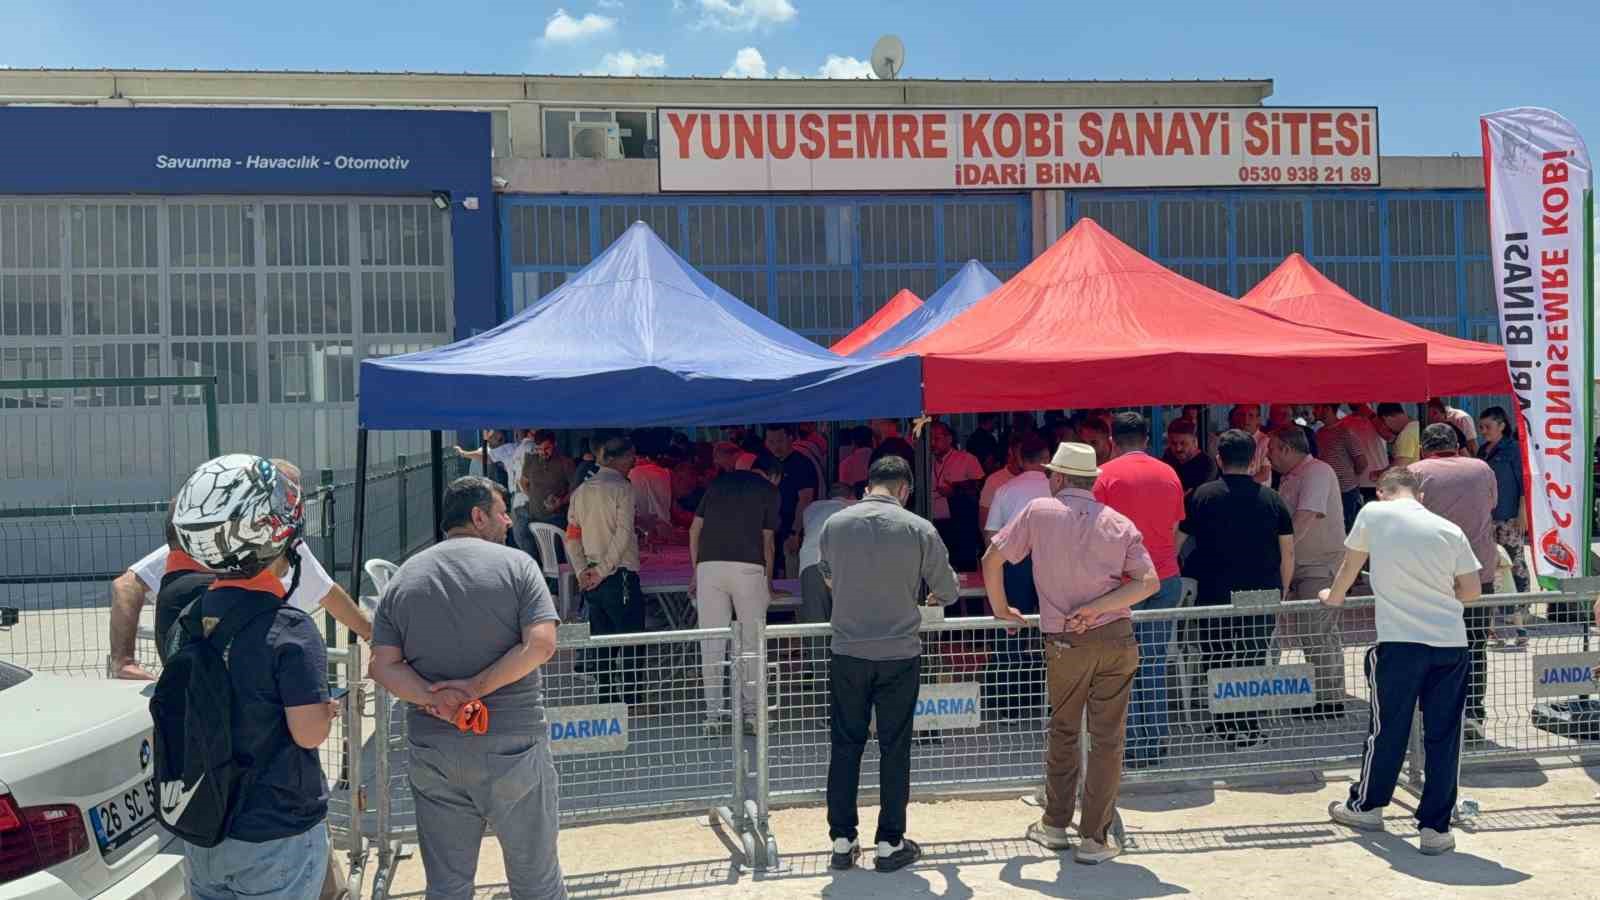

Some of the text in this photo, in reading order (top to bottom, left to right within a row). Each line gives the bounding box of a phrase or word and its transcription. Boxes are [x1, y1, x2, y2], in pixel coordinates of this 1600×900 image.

[667, 111, 948, 159] YUNUSEMRE
[155, 154, 232, 169] Savunma
[334, 154, 410, 170] Otomotiv
[1238, 166, 1371, 182] 0530 938 21 89
[1538, 666, 1593, 685] JANDA
[1214, 677, 1312, 699] JANDARMA
[914, 698, 976, 716] DARMA
[550, 717, 622, 740] DARMA
[100, 802, 122, 837] 26
[124, 788, 144, 821] SC
